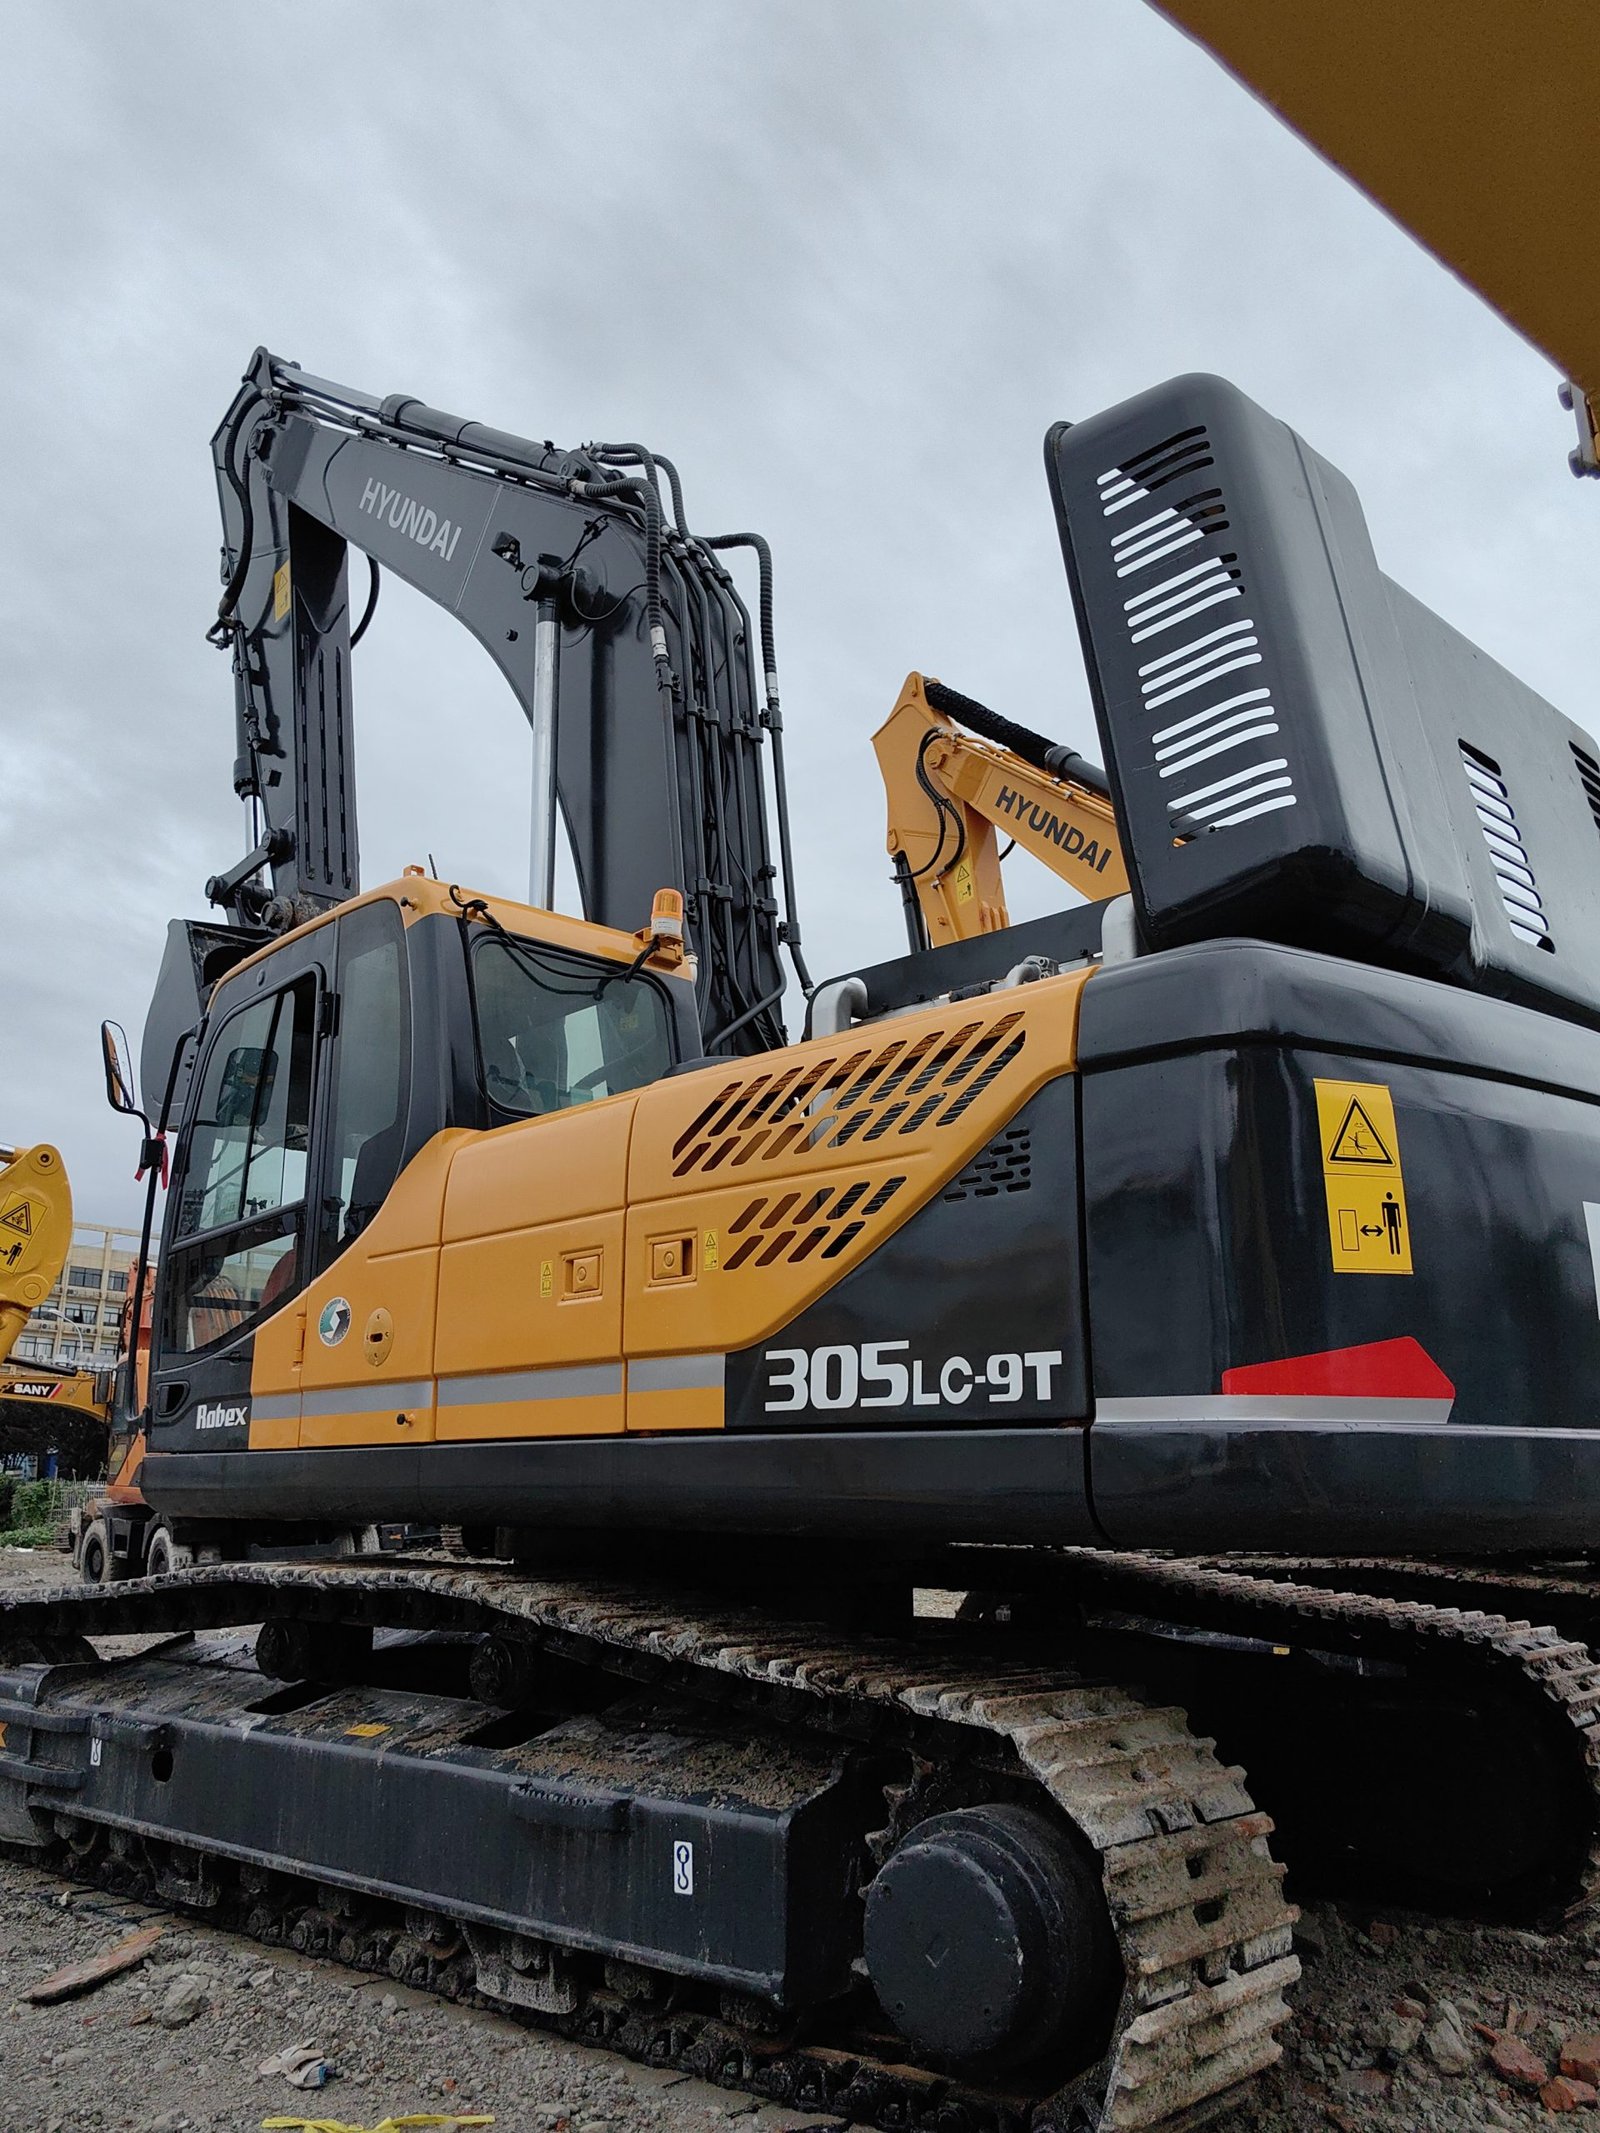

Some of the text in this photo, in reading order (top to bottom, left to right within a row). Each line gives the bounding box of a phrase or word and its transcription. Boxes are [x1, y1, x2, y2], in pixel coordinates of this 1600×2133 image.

[359, 477, 462, 562] HYUNDAI
[995, 785, 1112, 873] HYUNDAI
[14, 1383, 50, 1396] SANY
[196, 1402, 248, 1430] Robex
